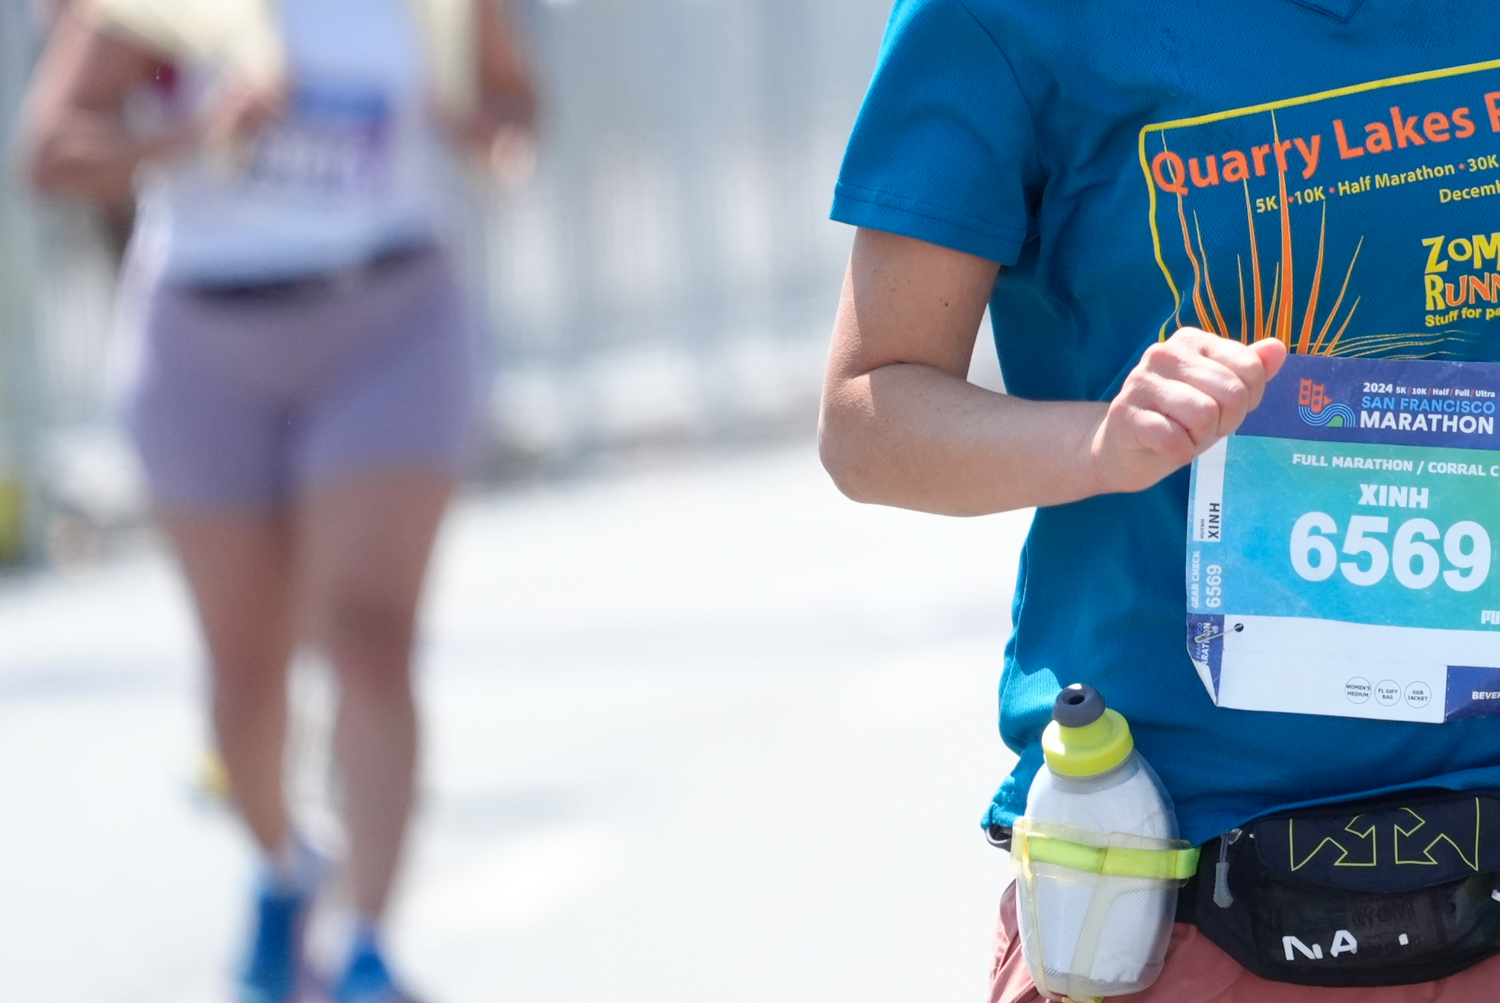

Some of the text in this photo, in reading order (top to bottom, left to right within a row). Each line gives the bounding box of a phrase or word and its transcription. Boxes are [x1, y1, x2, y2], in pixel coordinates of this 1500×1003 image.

[1151, 133, 1321, 195] Quarry
[1333, 106, 1475, 160] Lakes
[1255, 194, 1277, 213] 5K
[1294, 185, 1326, 206] 10K
[1338, 176, 1371, 197] Half
[1374, 162, 1455, 189] Marathon
[1467, 154, 1499, 173] 30K
[1425, 308, 1459, 328] Stuff
[1462, 305, 1482, 319] for
[1363, 382, 1393, 394] 2024
[1395, 386, 1407, 395] 5K
[1412, 387, 1427, 396] 10K
[1432, 388, 1450, 396] Half
[1455, 389, 1470, 398] Full
[1475, 390, 1496, 398] Ultra
[1361, 396, 1496, 415] SAN FRANCISCO
[1360, 410, 1494, 435] MARATHON
[1292, 453, 1329, 467] FULL
[1332, 456, 1413, 473] MARATHON
[1428, 462, 1487, 477] CORRAL
[1490, 465, 1499, 477] C
[1357, 483, 1429, 509] XINH
[1207, 502, 1221, 539] XINH
[1290, 511, 1492, 592] 6569
[1191, 551, 1200, 608] GEAR CHECK
[1206, 564, 1222, 608] 6569
[1346, 683, 1371, 691] WOMEN'S
